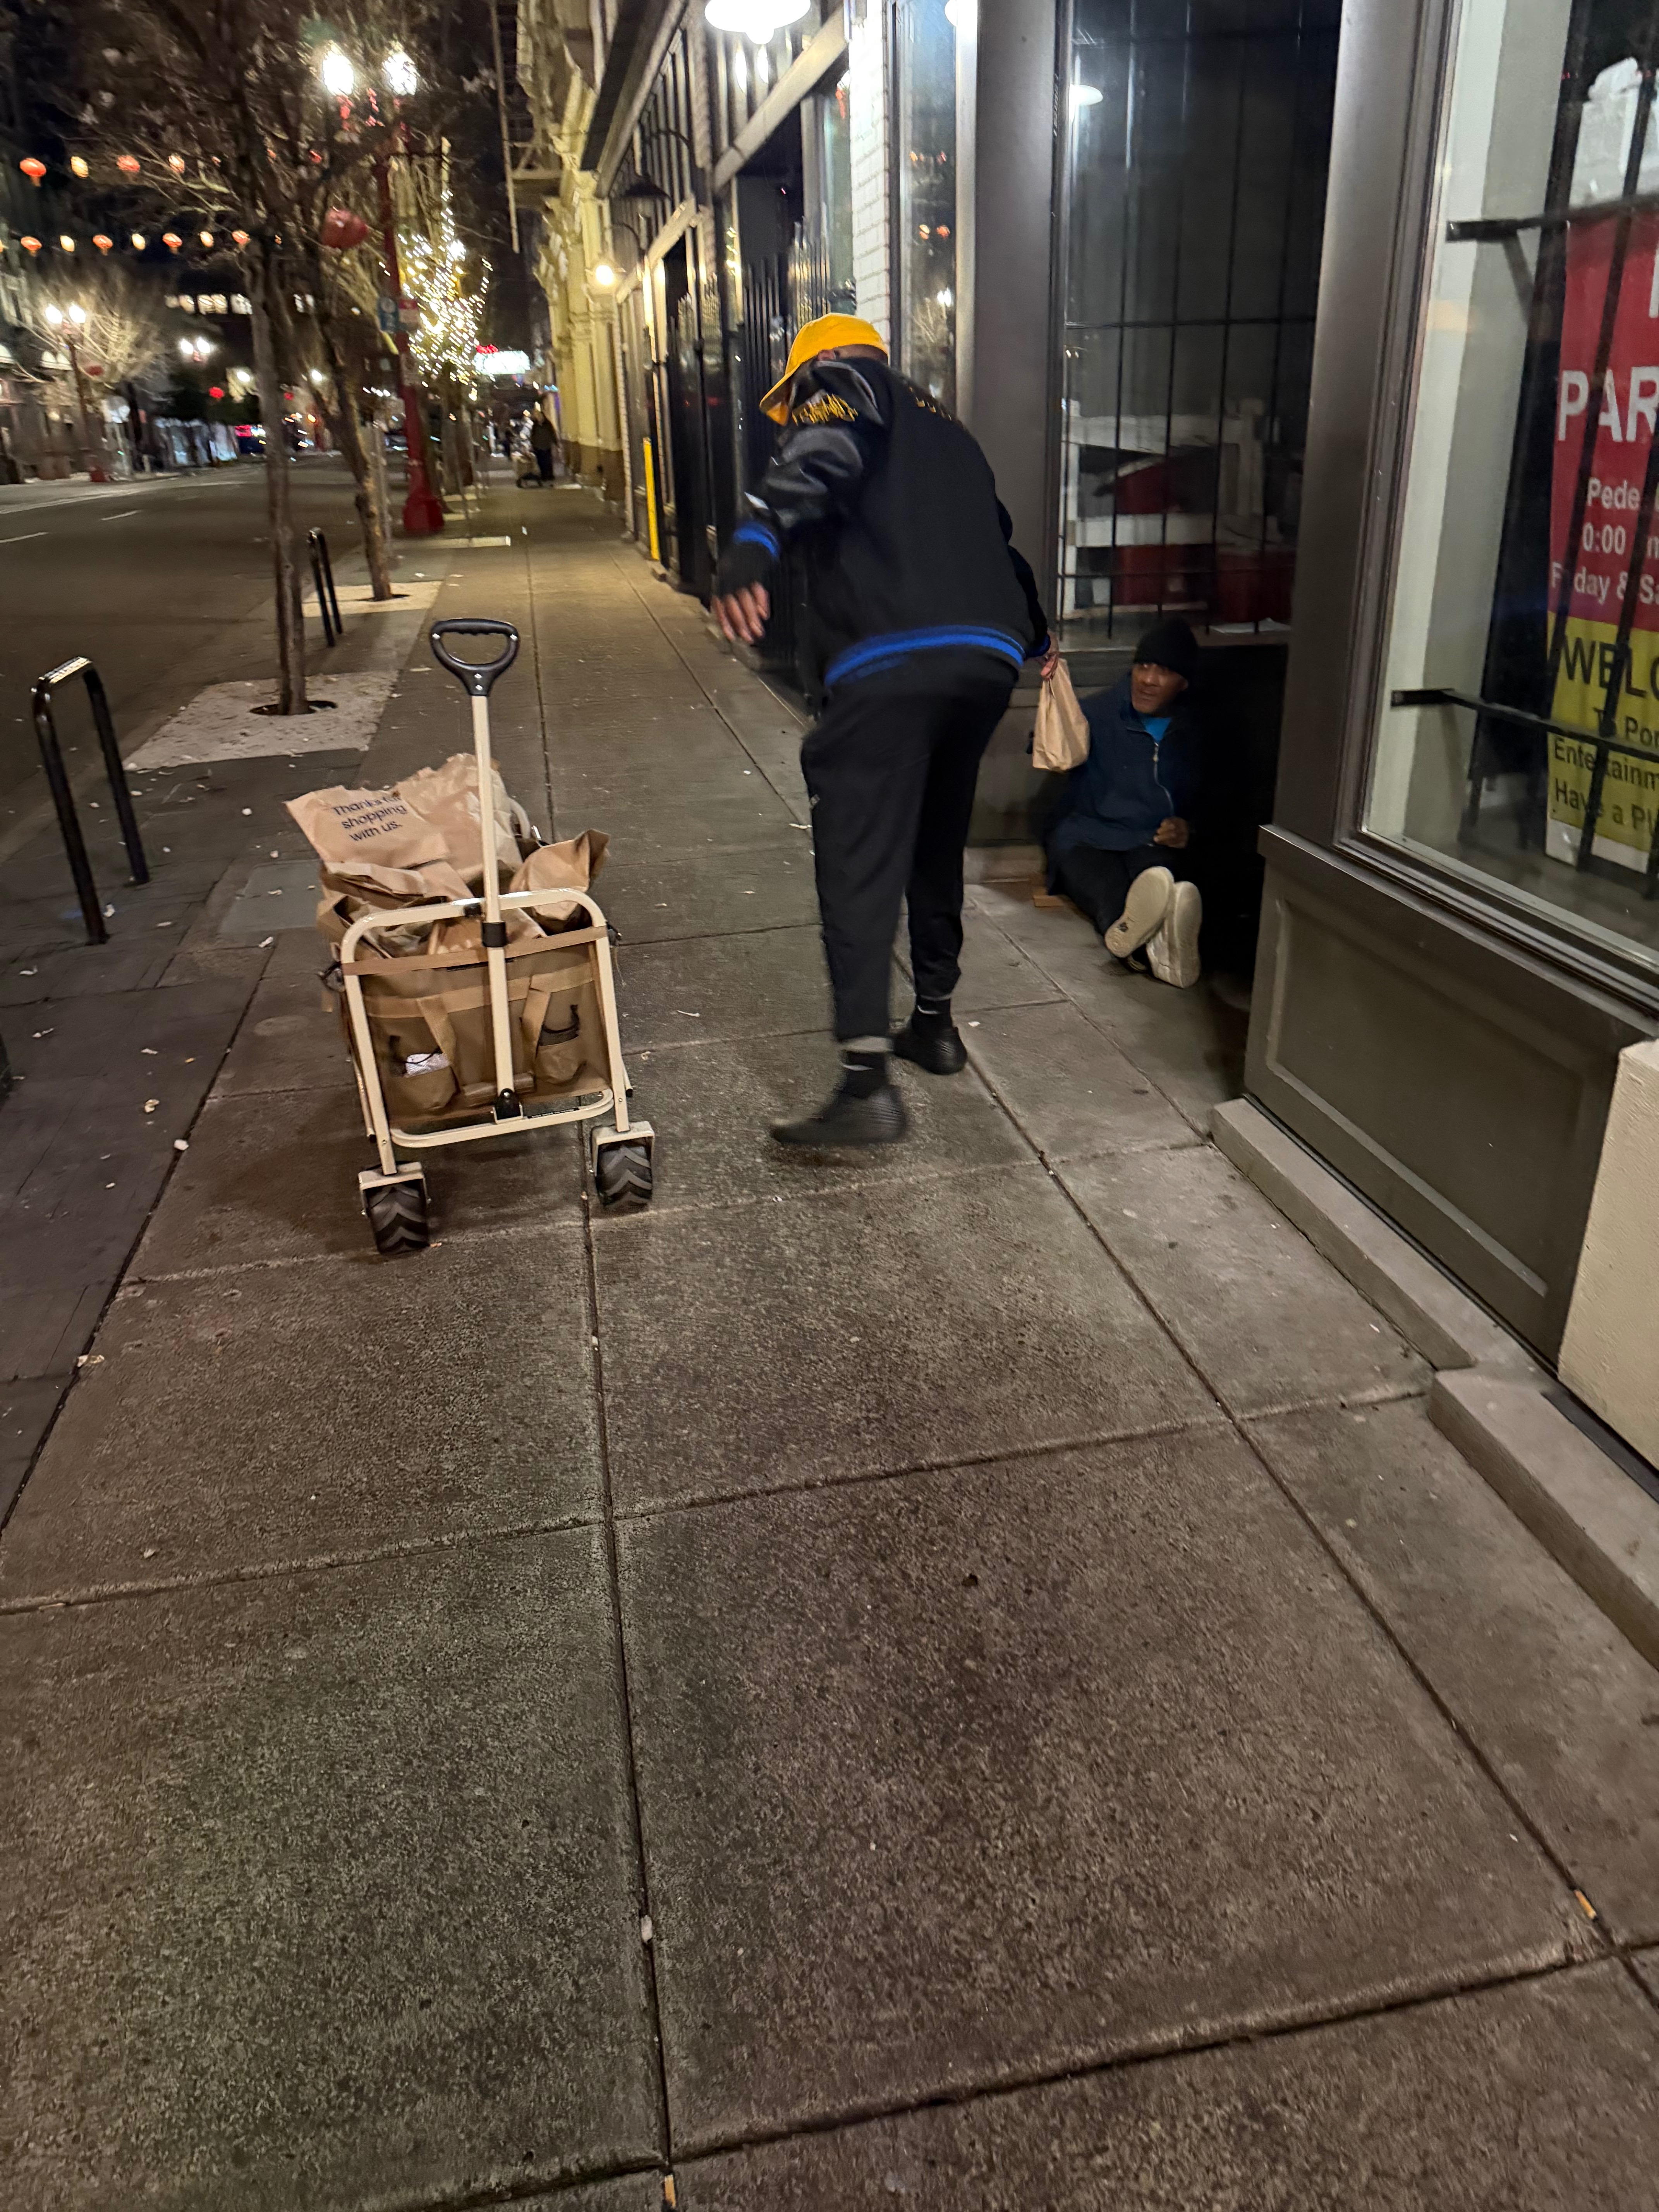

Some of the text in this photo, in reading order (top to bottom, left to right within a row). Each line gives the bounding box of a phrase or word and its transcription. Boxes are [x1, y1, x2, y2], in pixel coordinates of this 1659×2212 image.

[1587, 477, 1659, 512] Pede
[1551, 562, 1610, 605] Fday
[342, 805, 407, 829] shopping
[349, 821, 403, 841] with us.
